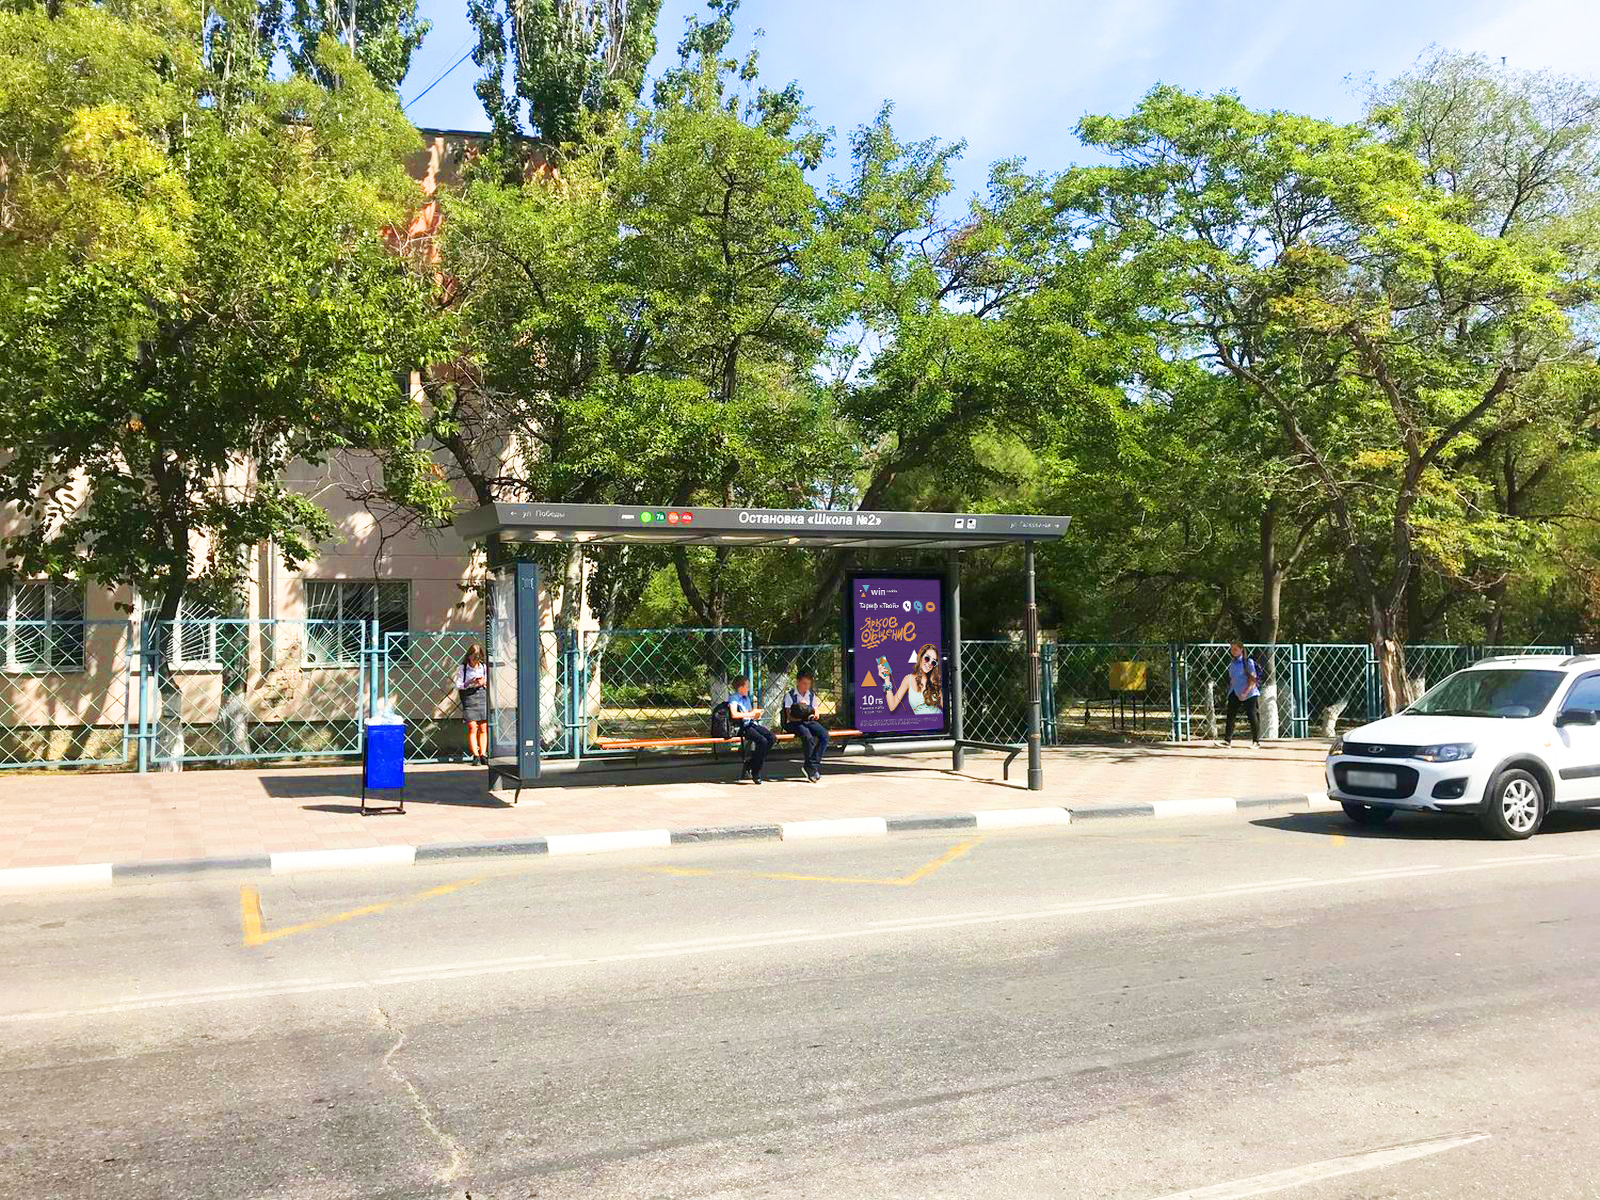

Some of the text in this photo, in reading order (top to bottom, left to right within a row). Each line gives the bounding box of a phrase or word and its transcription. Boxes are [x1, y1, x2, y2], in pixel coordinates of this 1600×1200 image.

[739, 511, 882, 526] Остановка «Школа №2»
[870, 587, 886, 596] win
[859, 602, 879, 611] Тариф
[862, 695, 875, 706] 10
